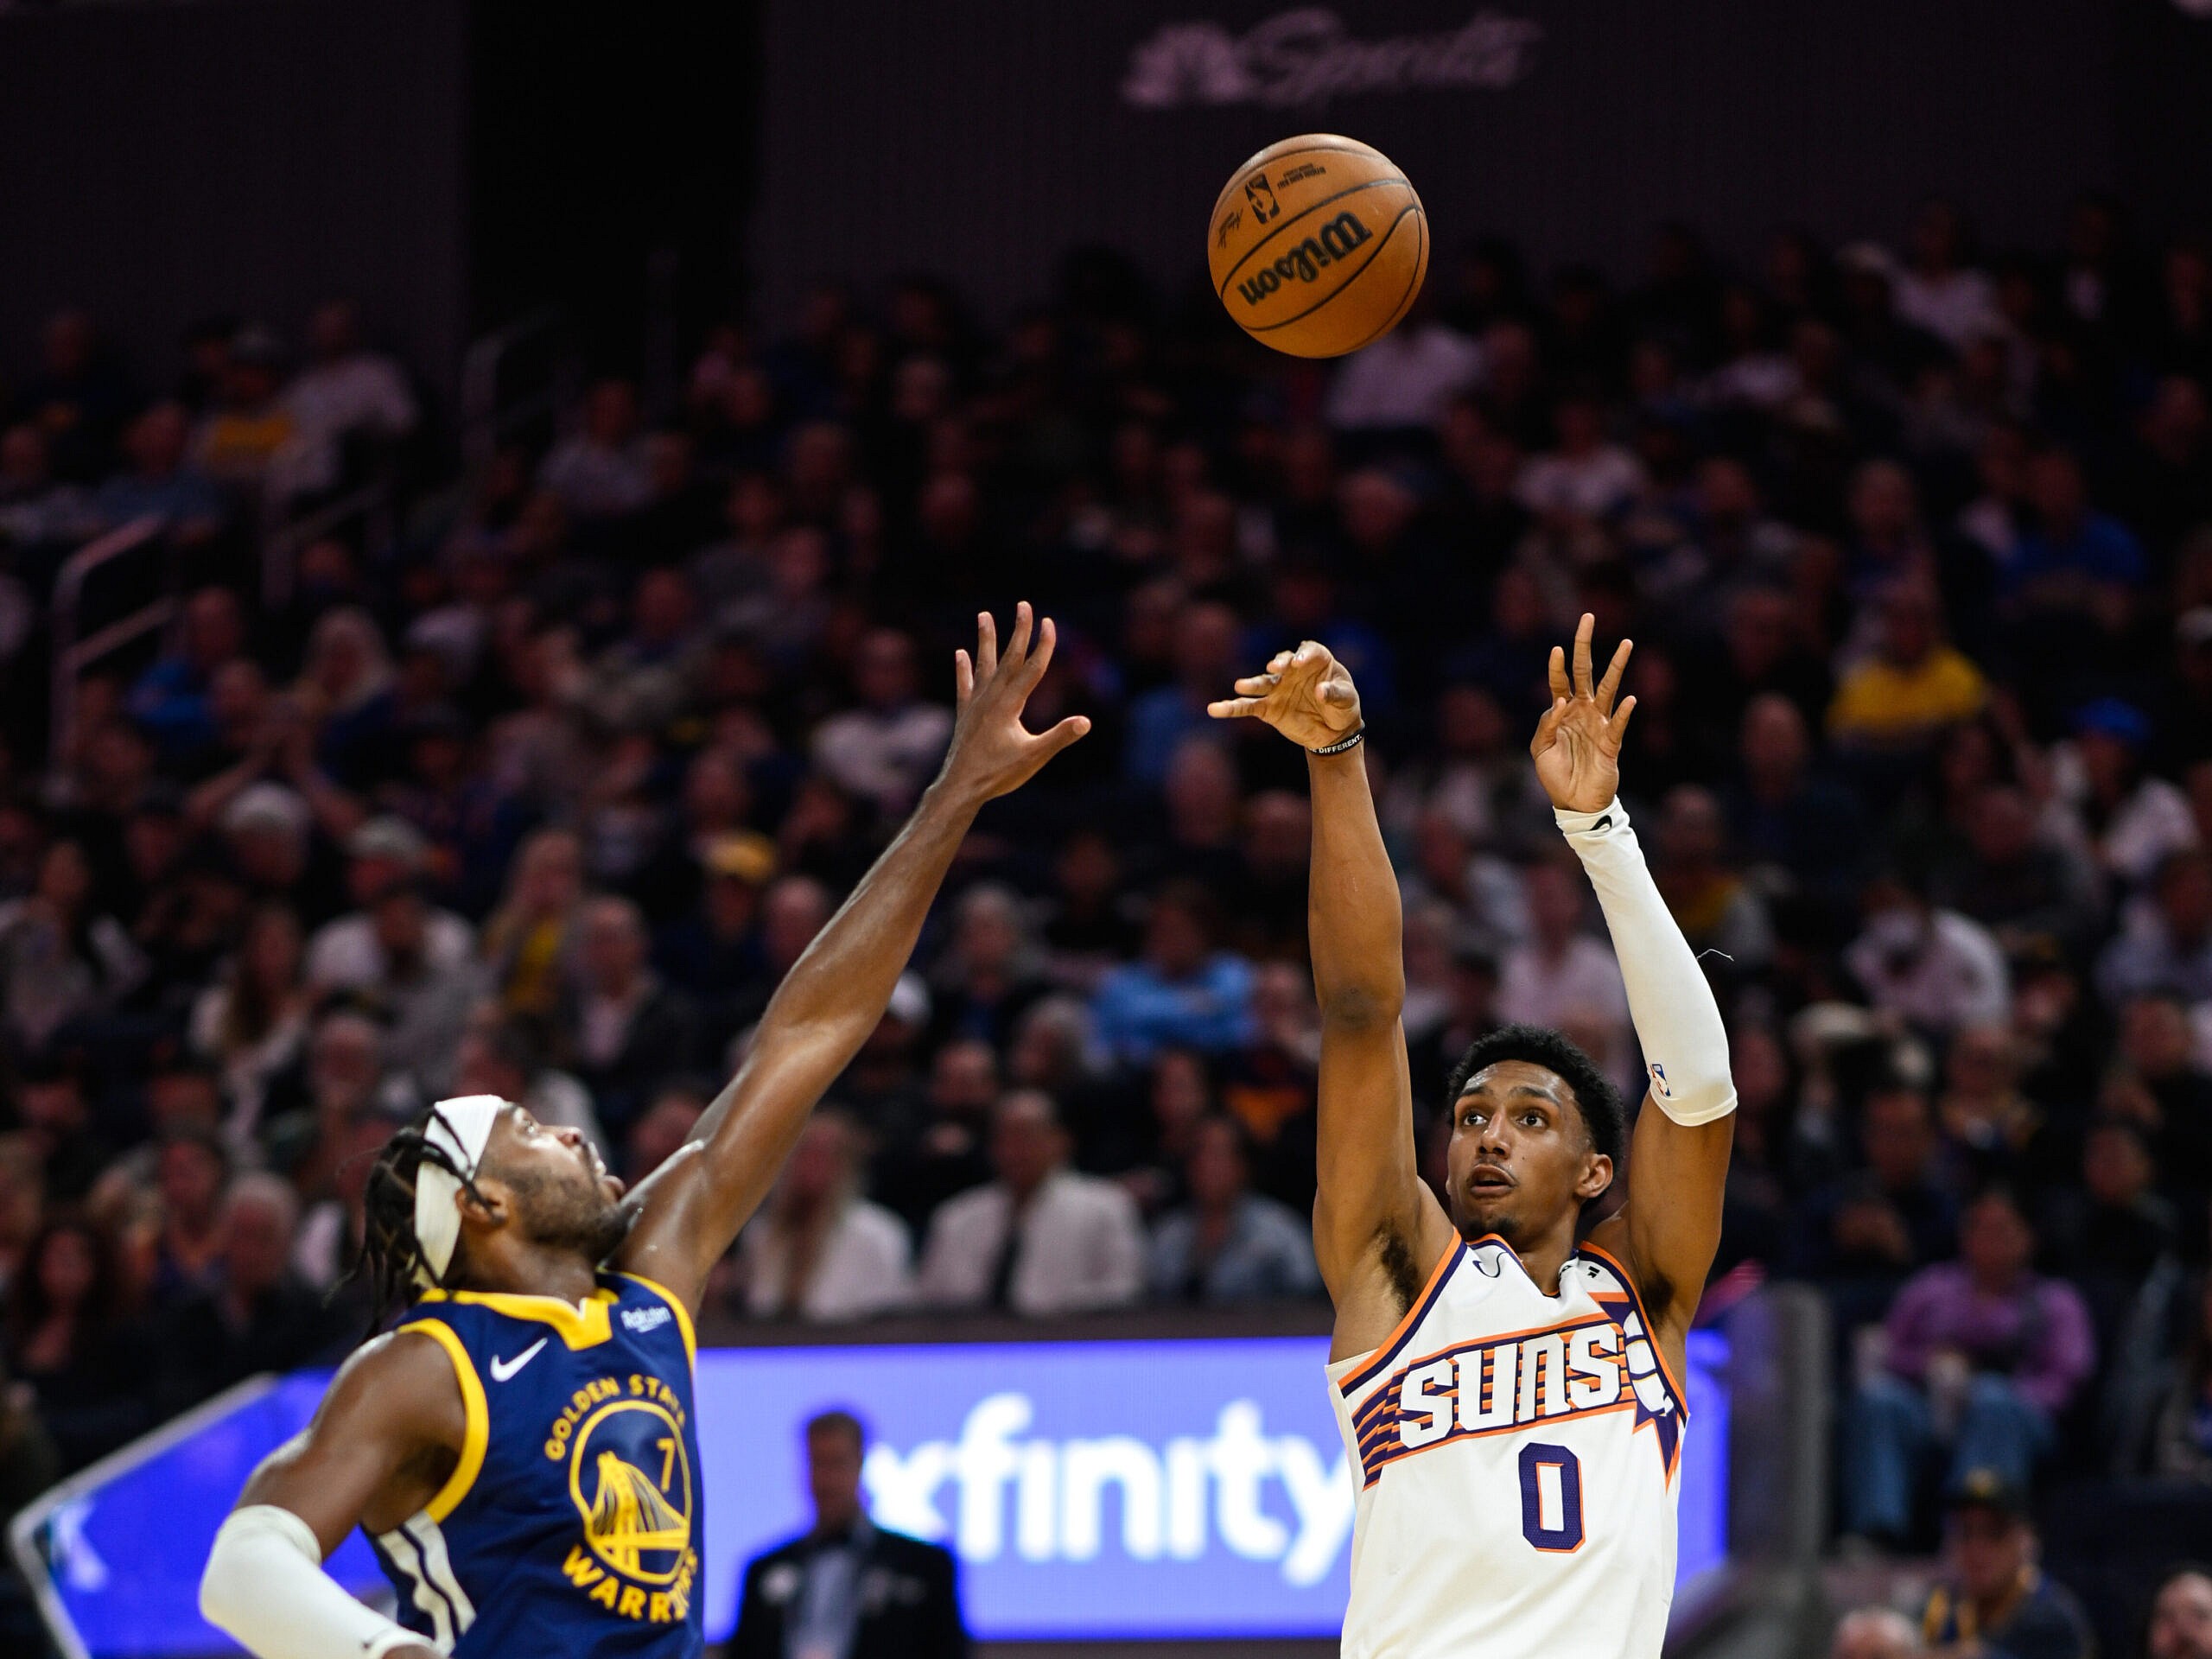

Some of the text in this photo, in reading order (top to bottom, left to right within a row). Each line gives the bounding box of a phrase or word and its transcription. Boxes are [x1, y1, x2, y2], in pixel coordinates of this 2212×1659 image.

[1237, 212, 1373, 306] Wilson
[1319, 734, 1363, 754] DIFFERENT.
[544, 1376, 620, 1462] GOLDEN
[1398, 1324, 1622, 1449] SUNS
[656, 1437, 675, 1493] 7
[862, 1393, 1353, 1588] xfinity
[1518, 1442, 1586, 1554] 0
[563, 1542, 698, 1624] WARR
